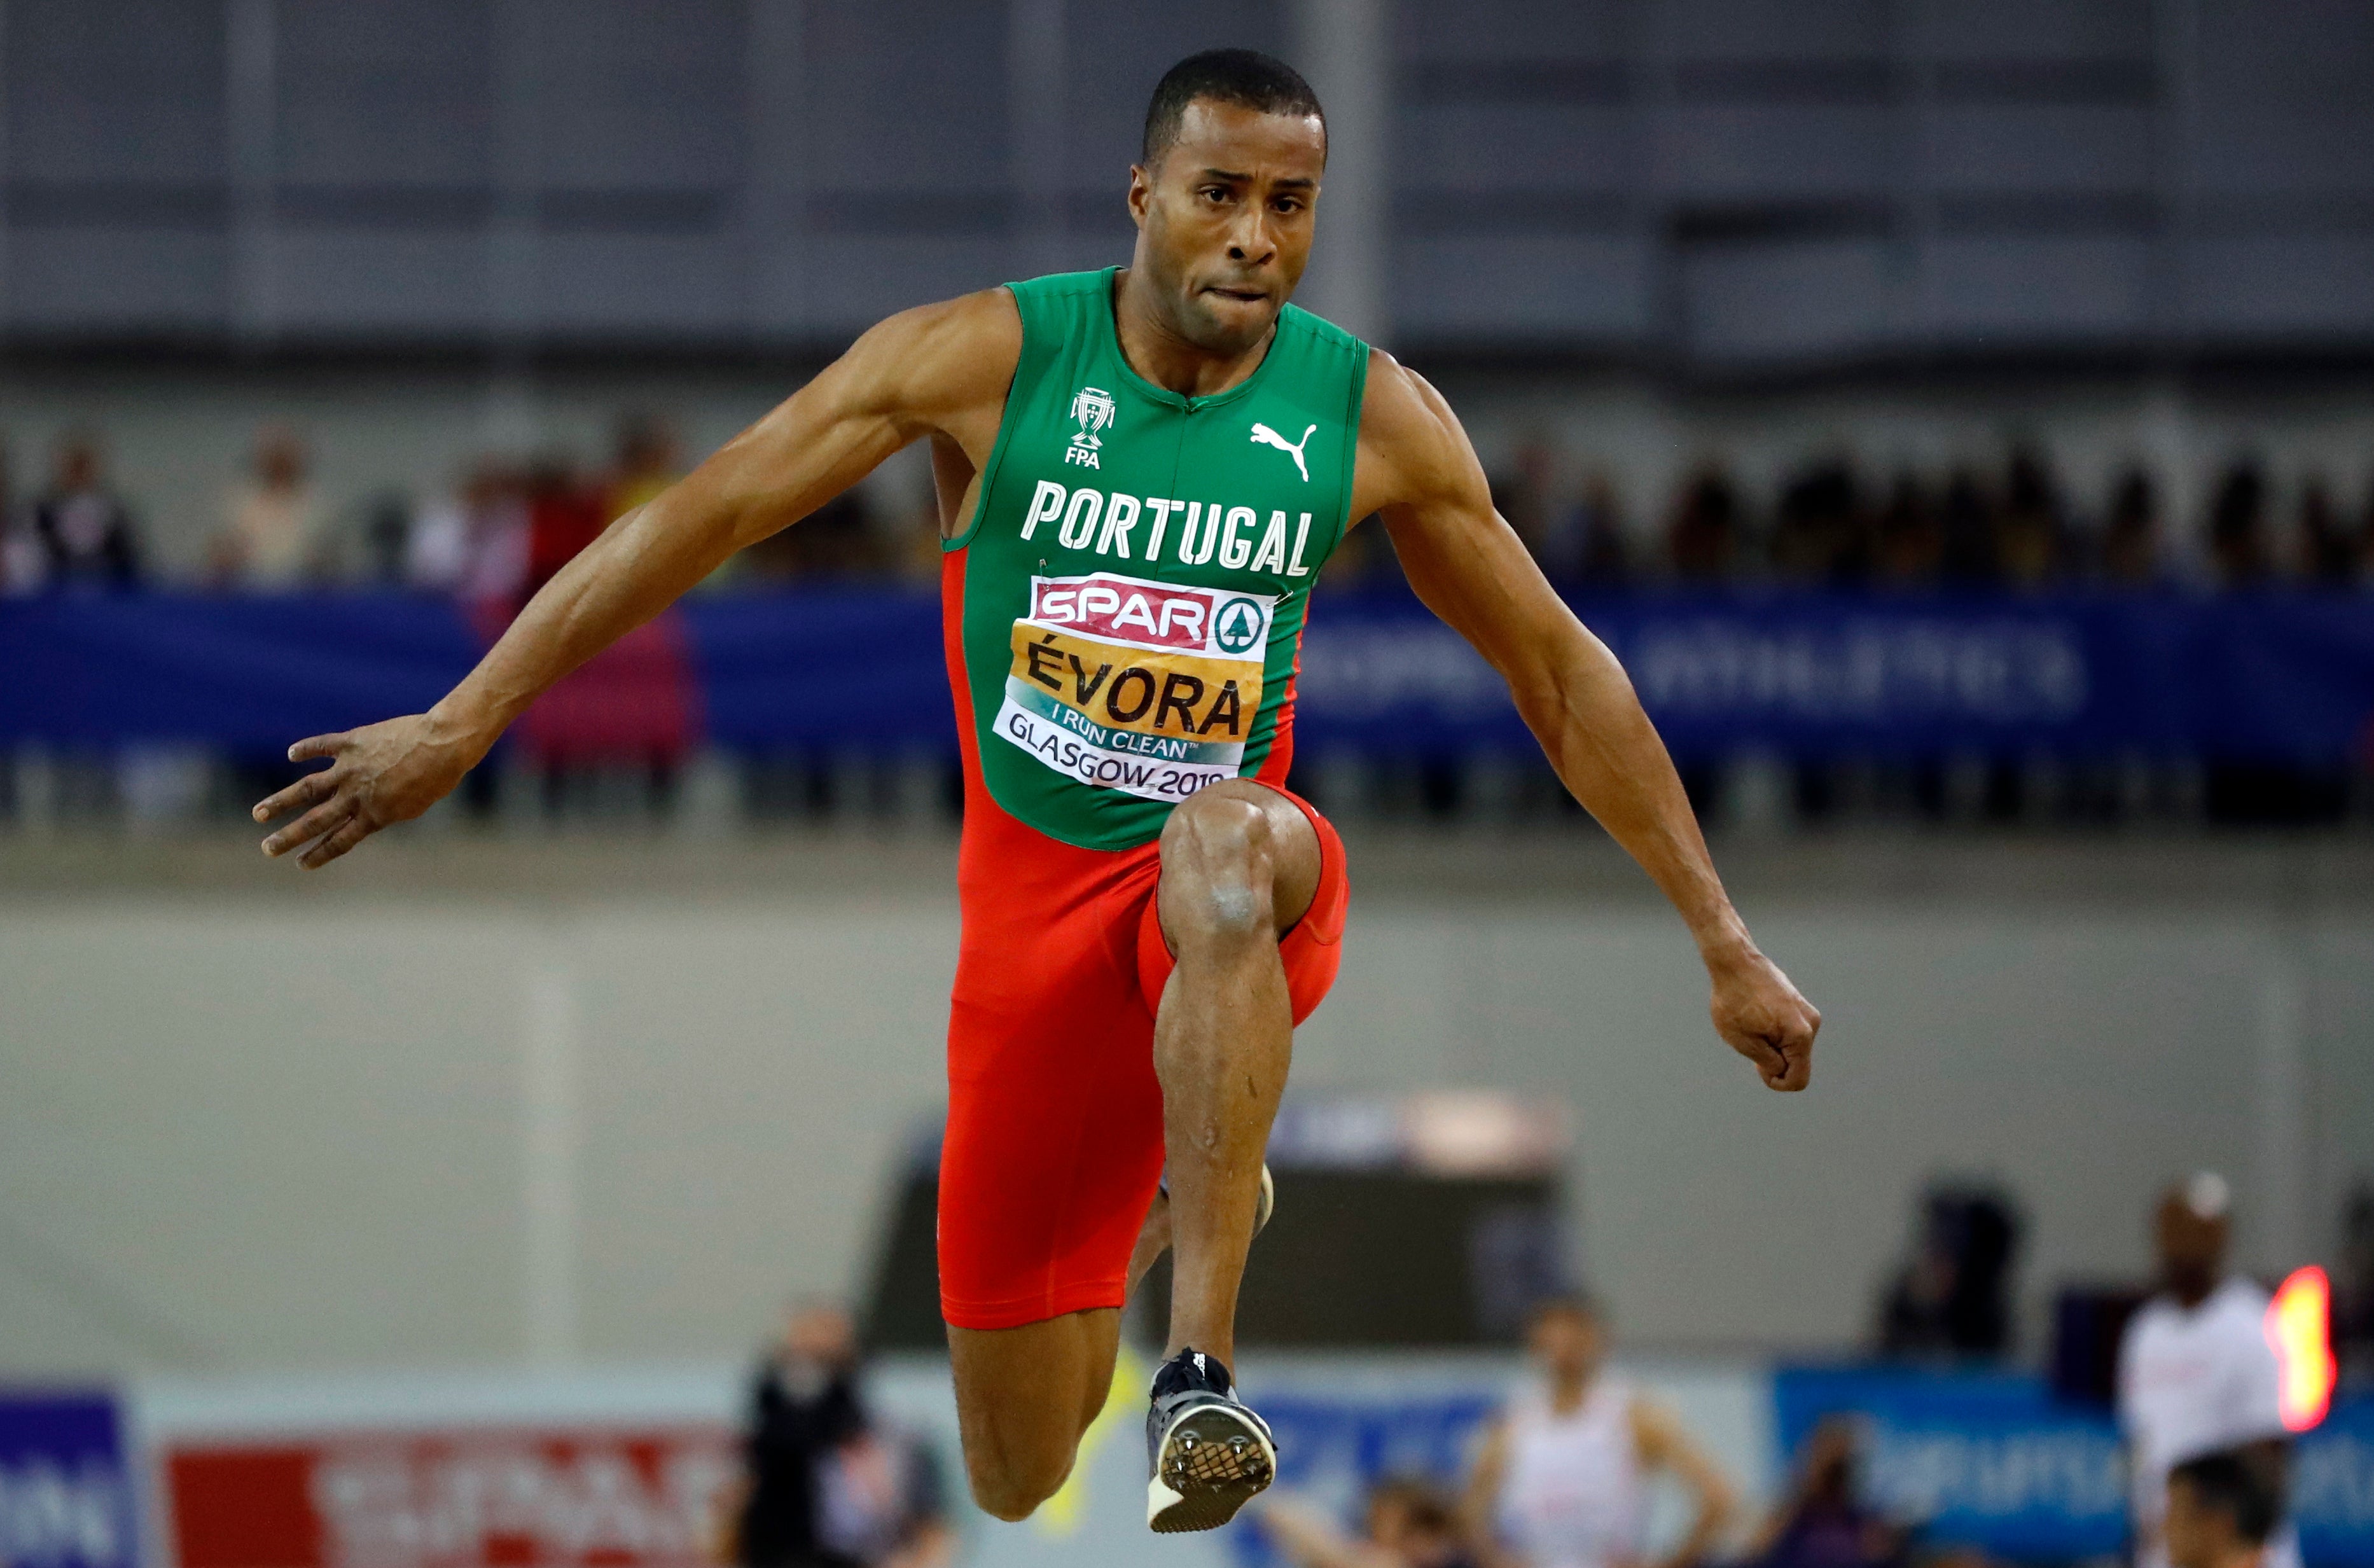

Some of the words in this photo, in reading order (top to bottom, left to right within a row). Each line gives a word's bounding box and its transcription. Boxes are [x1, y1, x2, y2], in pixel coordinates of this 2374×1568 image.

[1064, 446, 1100, 470] FPA
[1020, 479, 1312, 577] PORTUGAL
[1038, 586, 1207, 642] SPAR
[1027, 633, 1241, 736] ÉVORA
[1009, 712, 1155, 788] GLASGOW
[1052, 704, 1059, 719] I
[1063, 709, 1107, 745] RUN
